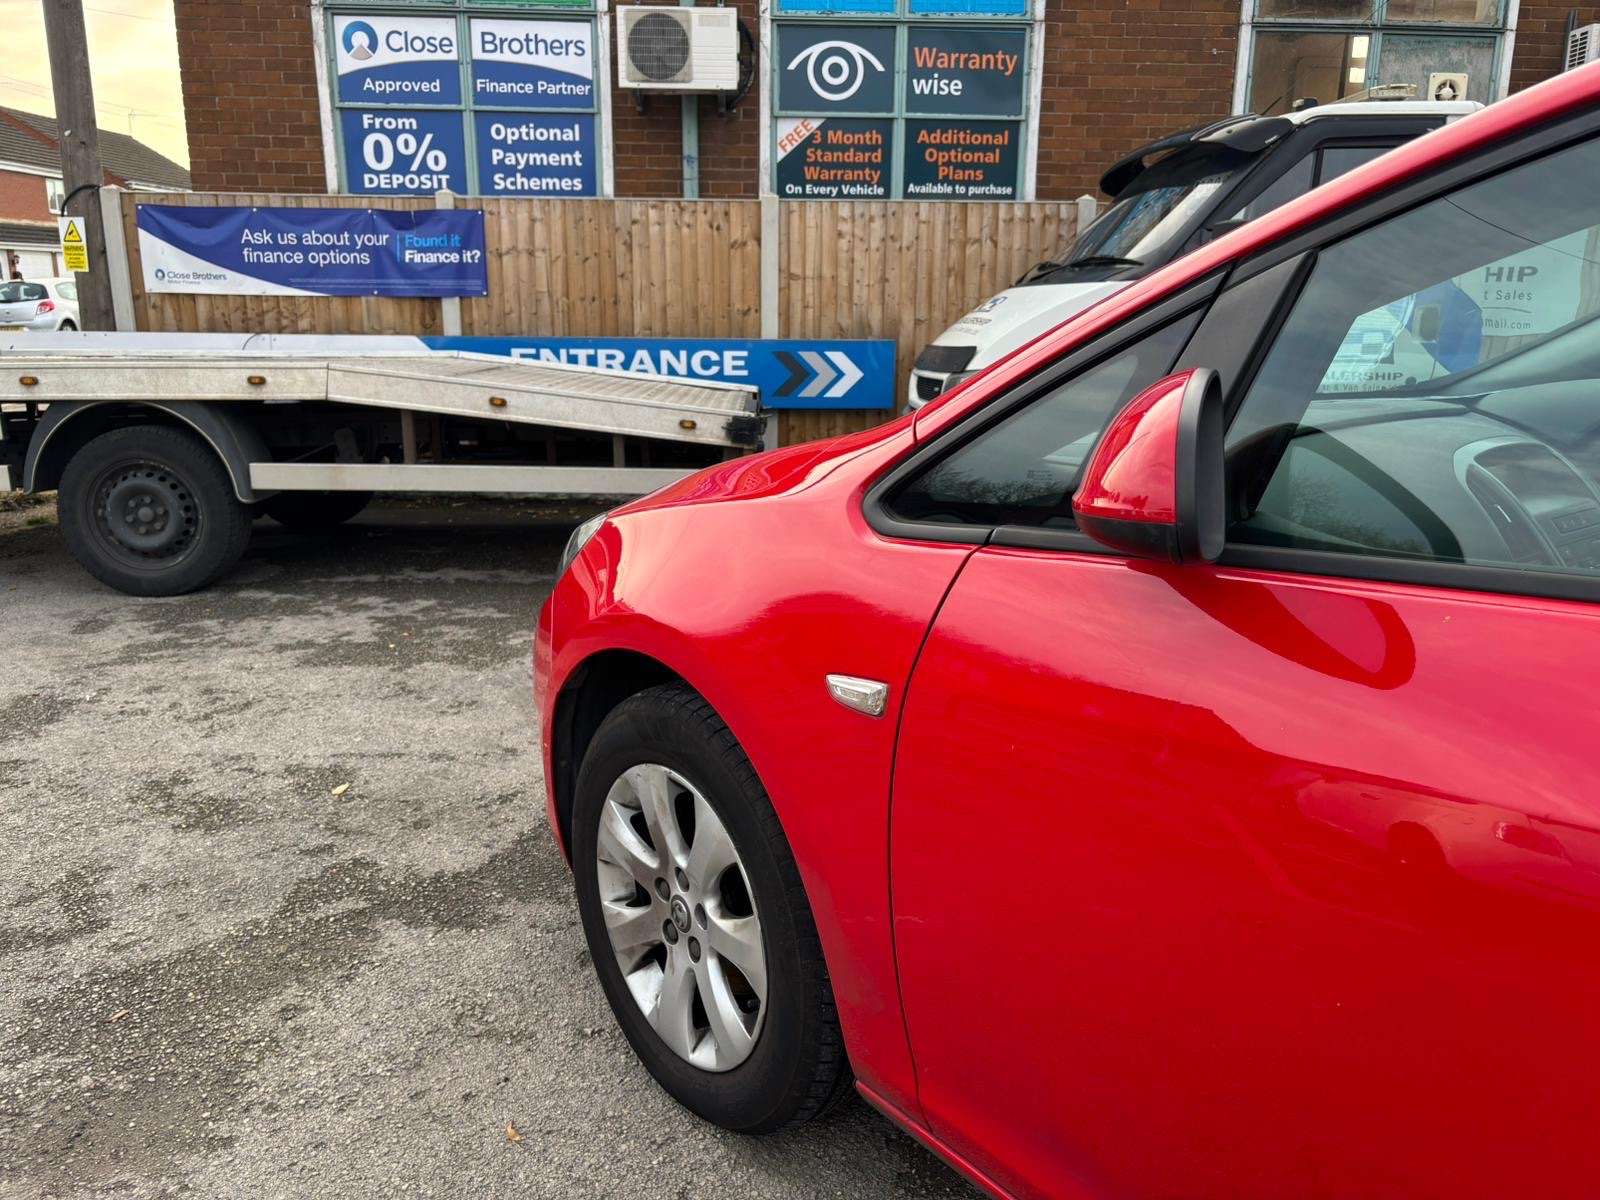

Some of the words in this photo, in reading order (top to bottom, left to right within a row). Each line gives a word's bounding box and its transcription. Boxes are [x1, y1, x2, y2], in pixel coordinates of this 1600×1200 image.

[385, 30, 453, 54] Close
[480, 31, 586, 57] Brothers
[914, 47, 1018, 76] Warranty
[363, 77, 440, 94] Approved
[476, 79, 534, 94] Finance
[537, 81, 591, 96] Partner
[912, 73, 963, 96] wise
[362, 114, 417, 130] From
[490, 124, 580, 144] Optional
[778, 118, 813, 154] FREE
[811, 131, 822, 145] 3
[827, 130, 882, 145] Month
[917, 130, 1009, 145] Additional
[362, 133, 447, 172] 0%
[491, 149, 583, 168] Payment
[806, 148, 882, 163] Standard
[925, 148, 1000, 165] Optional
[363, 174, 450, 190] DEPOSIT
[804, 166, 881, 184] Warranty
[938, 166, 984, 181] Plans
[493, 174, 583, 191] Schemes
[785, 184, 802, 194] On
[805, 185, 839, 197] Every
[843, 184, 885, 196] Vehicle
[907, 183, 951, 195] Available
[955, 184, 966, 194] to
[968, 184, 1013, 196] purchase
[241, 228, 273, 245] Ask
[278, 232, 297, 245] us
[302, 230, 350, 246] about
[354, 234, 389, 249] your
[405, 234, 448, 247] Found
[451, 234, 461, 247] it
[242, 248, 304, 263] finance
[308, 250, 371, 267] options
[405, 250, 460, 263] Finance
[462, 250, 481, 263] it?
[167, 271, 190, 280] Close
[192, 272, 227, 281] Brothers
[1484, 265, 1538, 283] HIP
[1496, 289, 1532, 300] Sales
